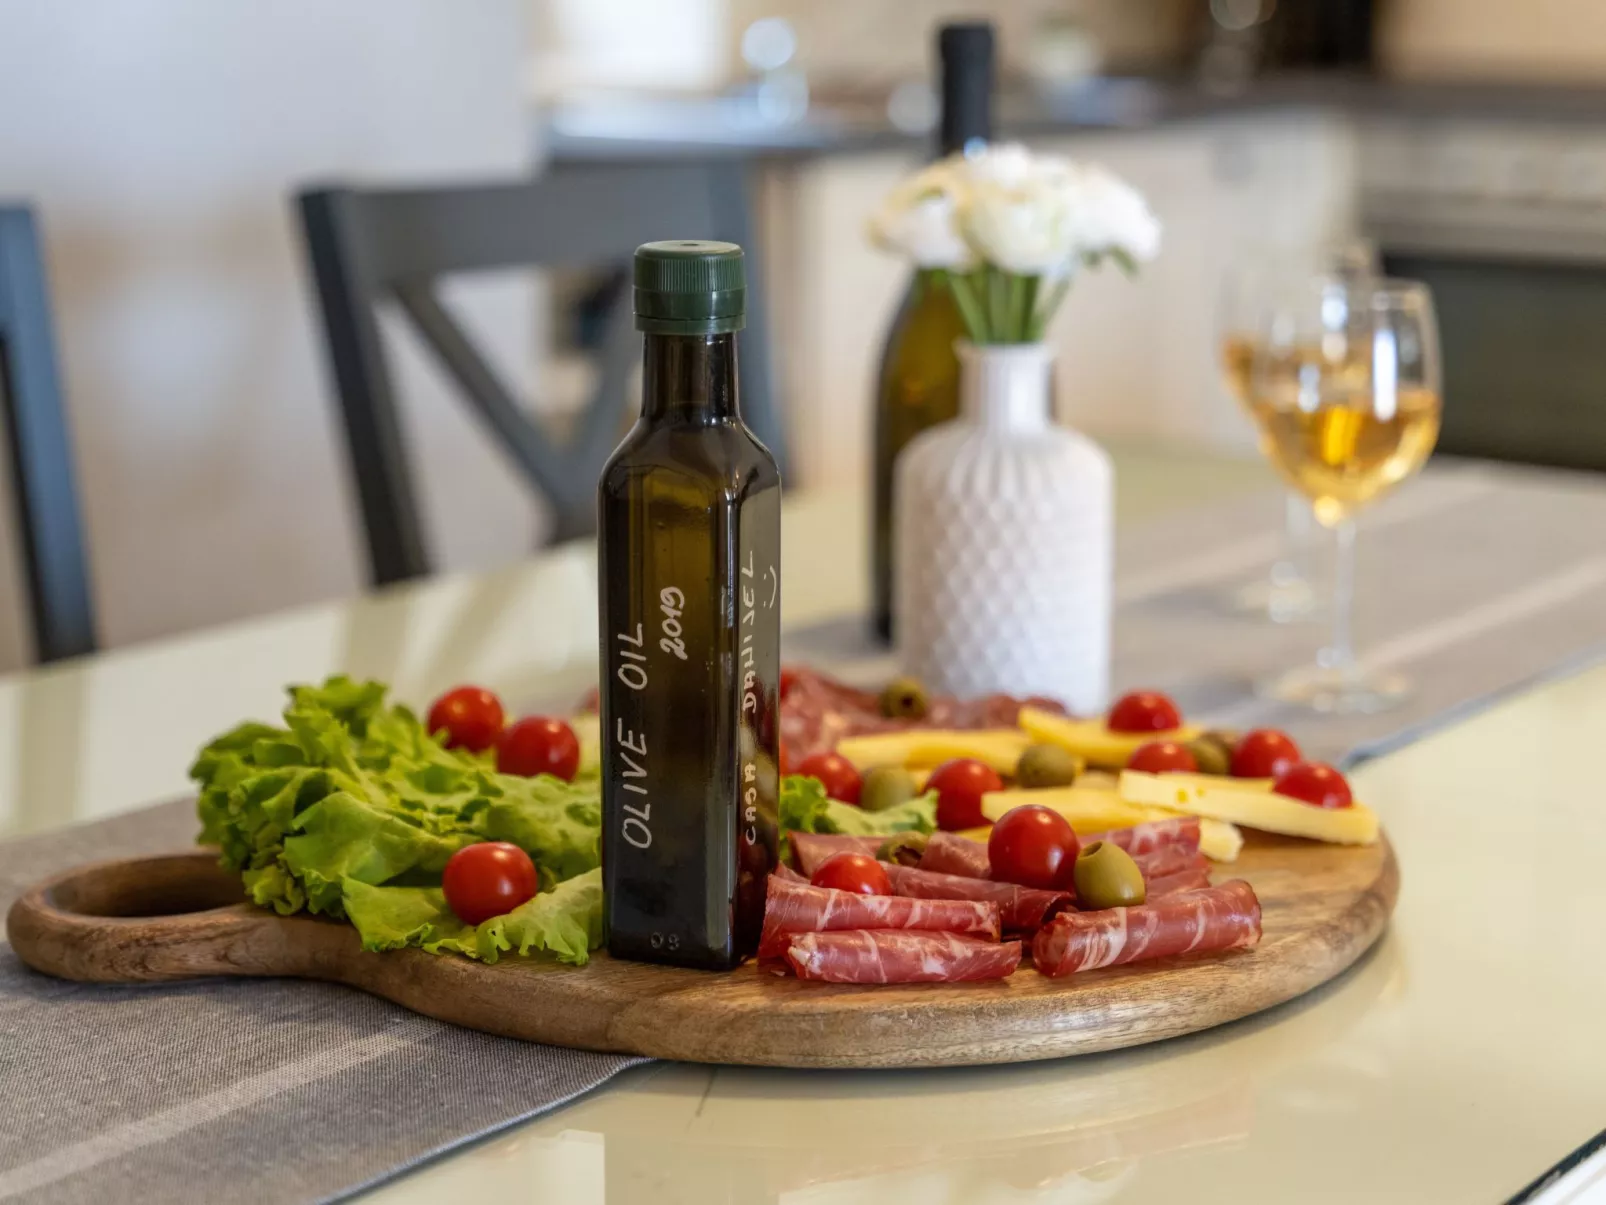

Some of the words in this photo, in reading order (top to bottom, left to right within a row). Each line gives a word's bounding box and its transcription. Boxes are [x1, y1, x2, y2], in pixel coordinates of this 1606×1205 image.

[617, 623, 648, 690] OIL
[659, 586, 688, 660] 2019
[617, 717, 652, 849] OLIVE
[744, 762, 758, 846] CASA
